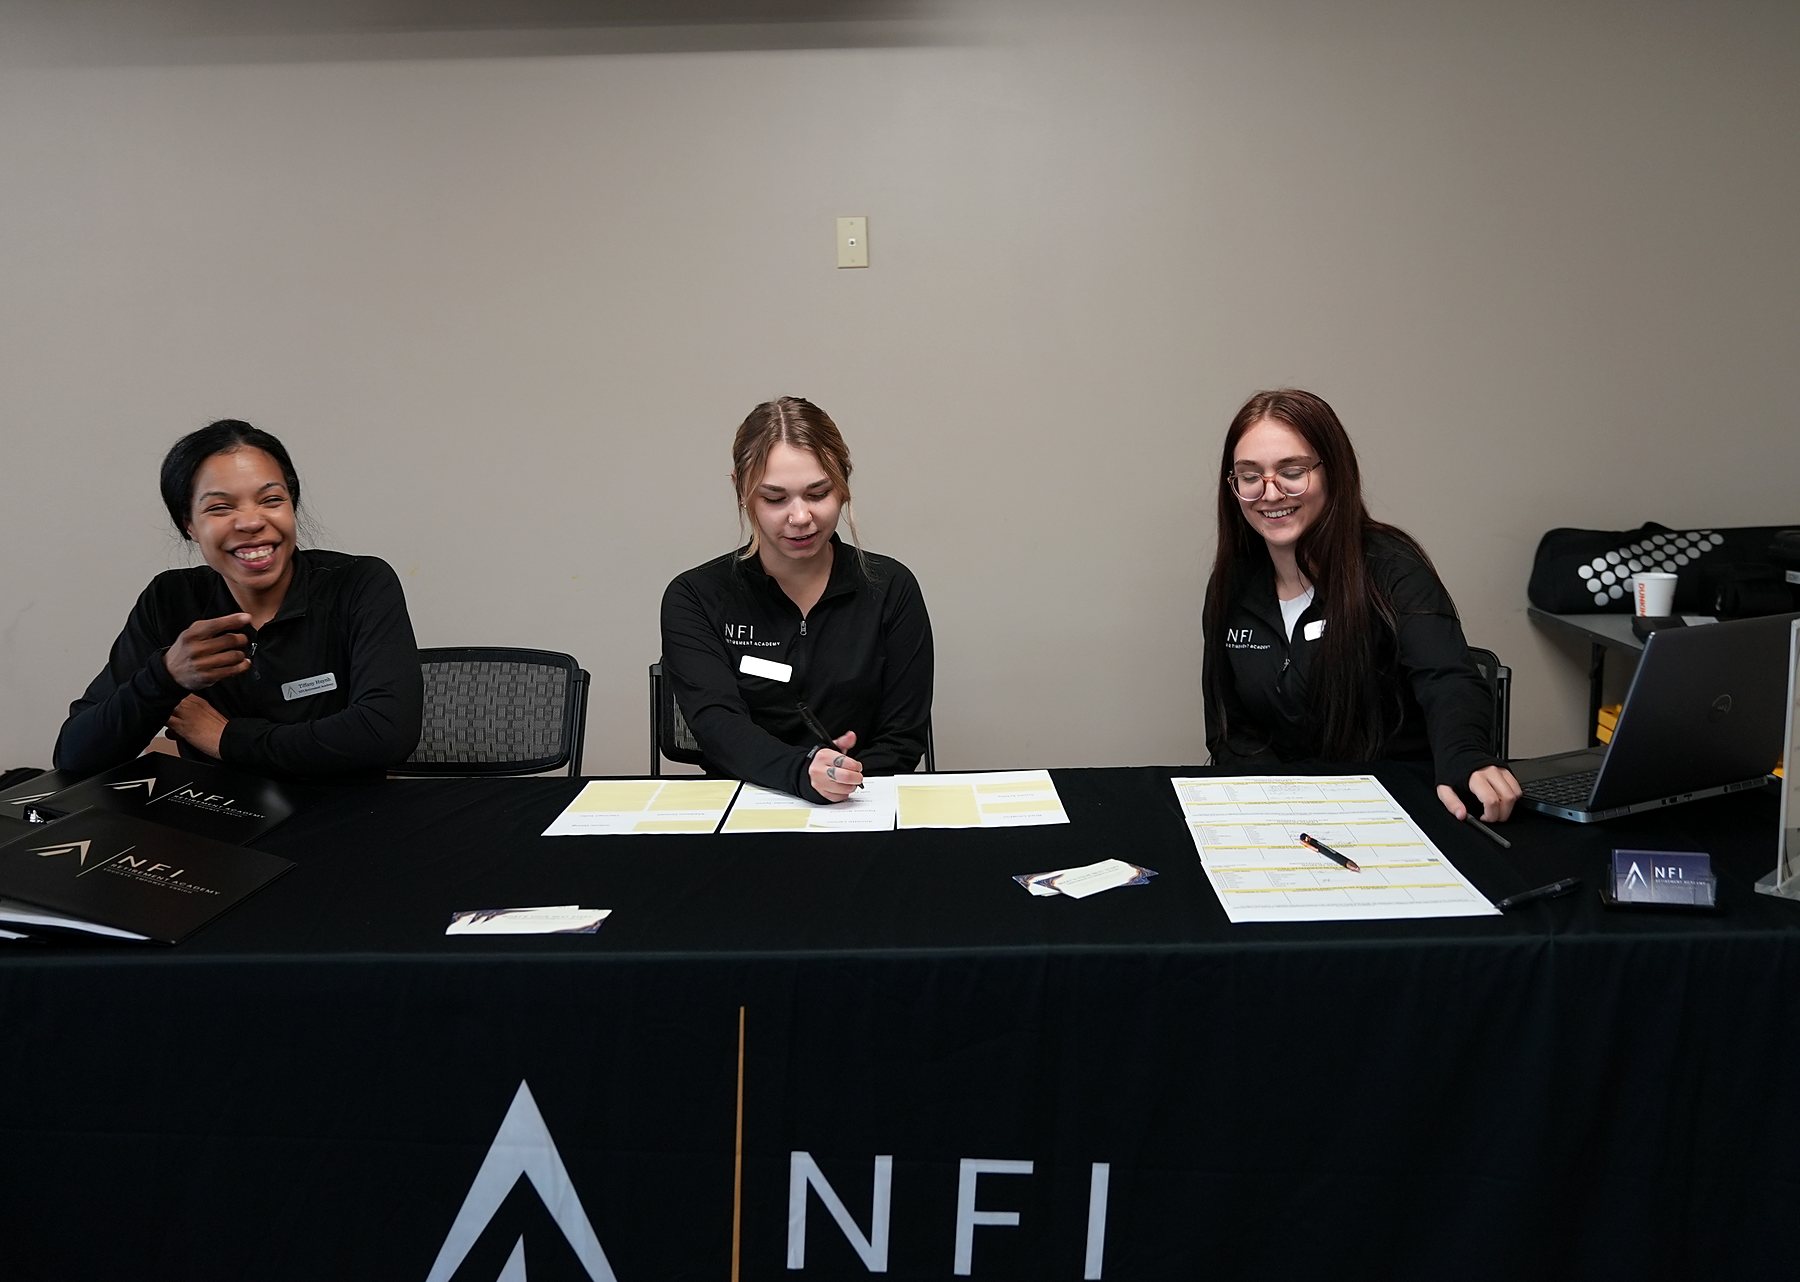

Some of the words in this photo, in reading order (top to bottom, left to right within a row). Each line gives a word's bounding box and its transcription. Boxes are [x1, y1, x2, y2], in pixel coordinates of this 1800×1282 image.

[725, 623, 753, 639] NFI
[1227, 628, 1253, 642] NFI
[179, 789, 235, 806] NFI
[117, 855, 185, 878] NFI
[1654, 866, 1682, 879] NFI
[110, 863, 170, 882] RETIREMENT
[171, 880, 221, 895] ACADEMY
[786, 1150, 1110, 1280] NFI
